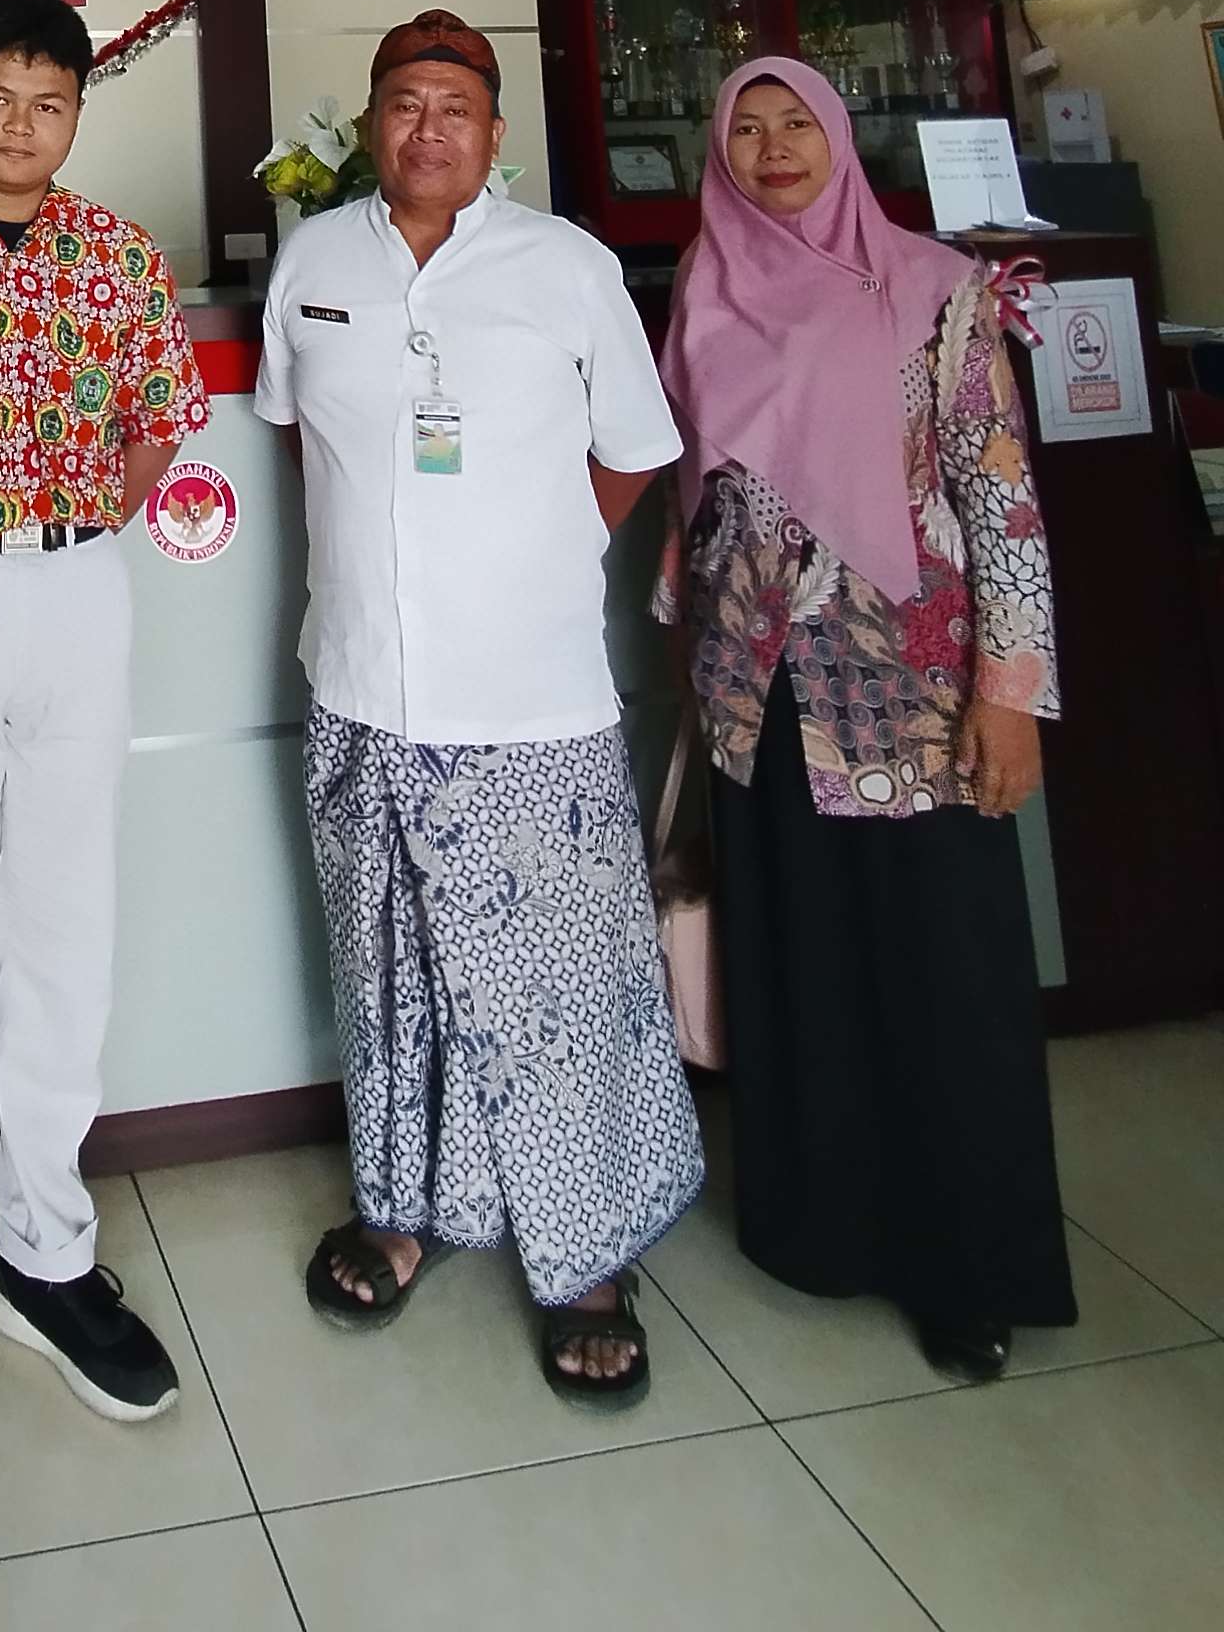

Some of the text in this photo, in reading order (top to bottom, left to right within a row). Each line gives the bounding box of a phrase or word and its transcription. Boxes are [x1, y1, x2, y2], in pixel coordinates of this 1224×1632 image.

[156, 463, 225, 490] DIRGAHAYU
[149, 517, 236, 561] REPUBLIK INDONESIA
